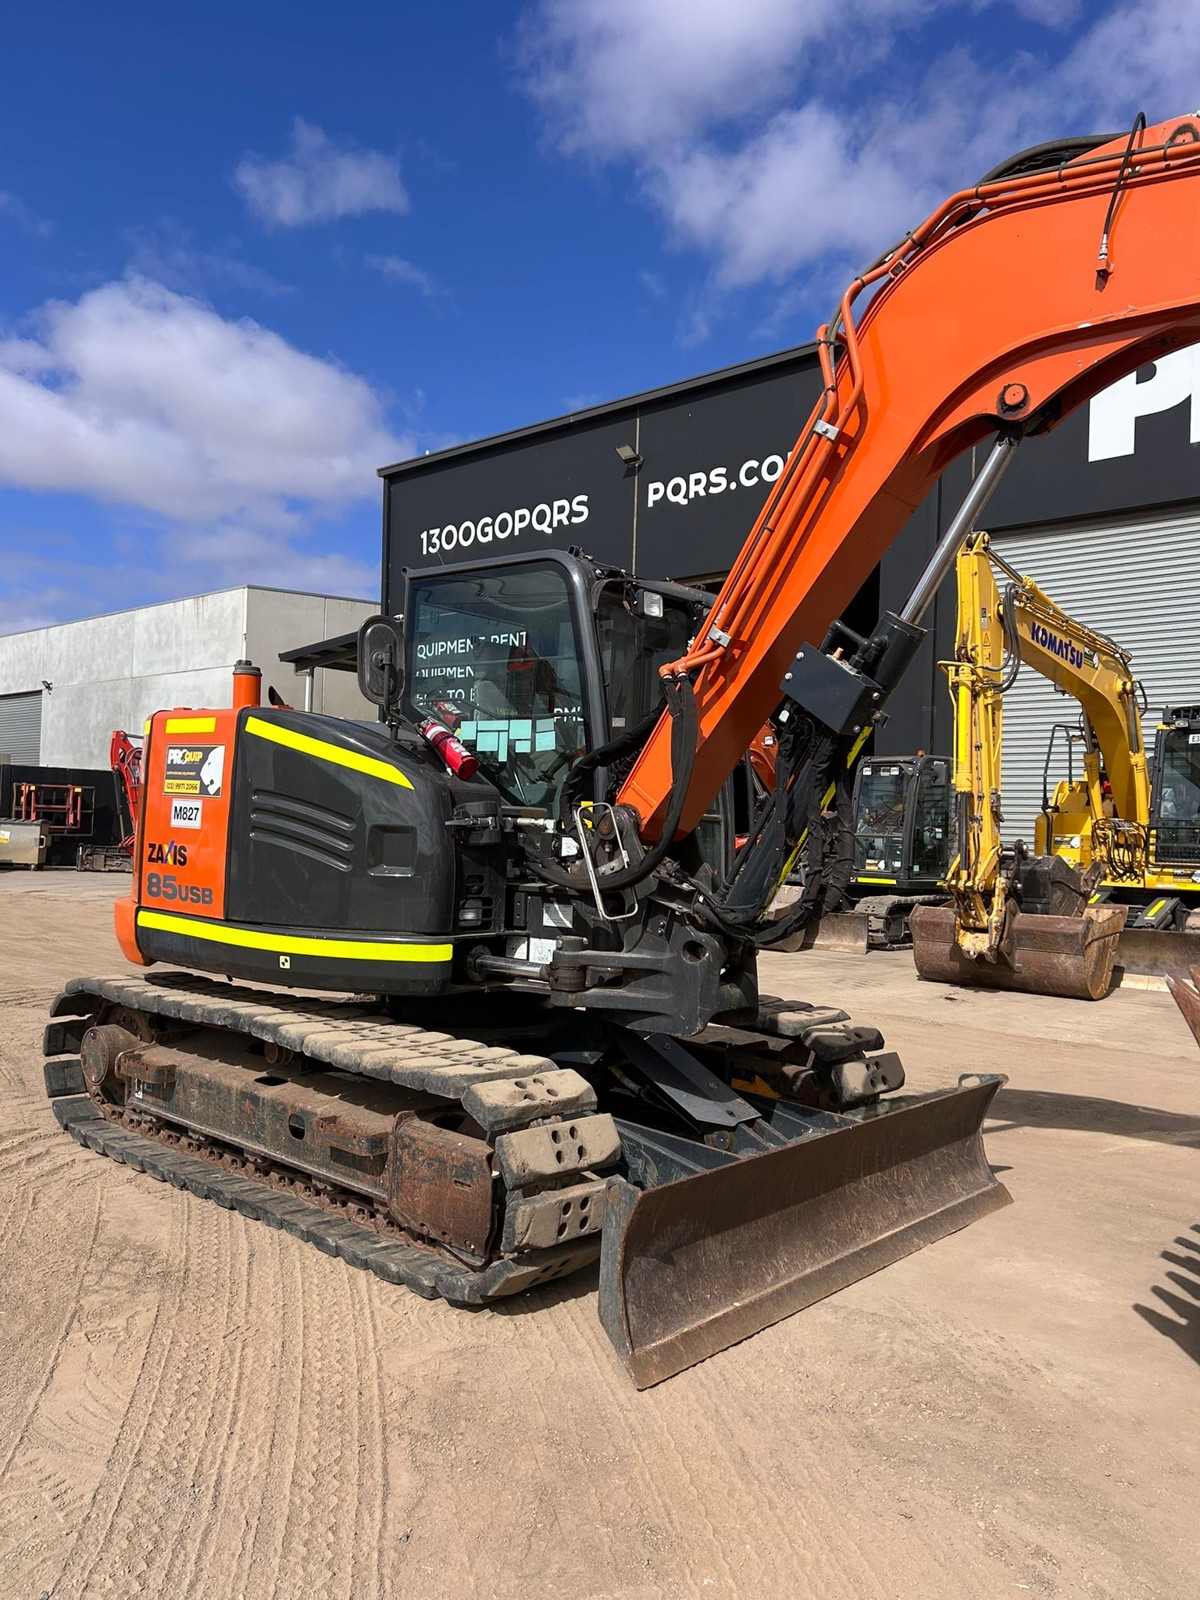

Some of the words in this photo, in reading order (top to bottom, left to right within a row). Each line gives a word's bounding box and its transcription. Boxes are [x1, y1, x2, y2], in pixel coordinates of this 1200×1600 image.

[1088, 341, 1200, 463] P
[647, 450, 793, 508] PQRS.CO
[420, 494, 589, 555] 1300GOPQRS
[1031, 621, 1083, 669] KOMATSU
[173, 806, 200, 821] M827
[147, 840, 188, 867] ZAXIS
